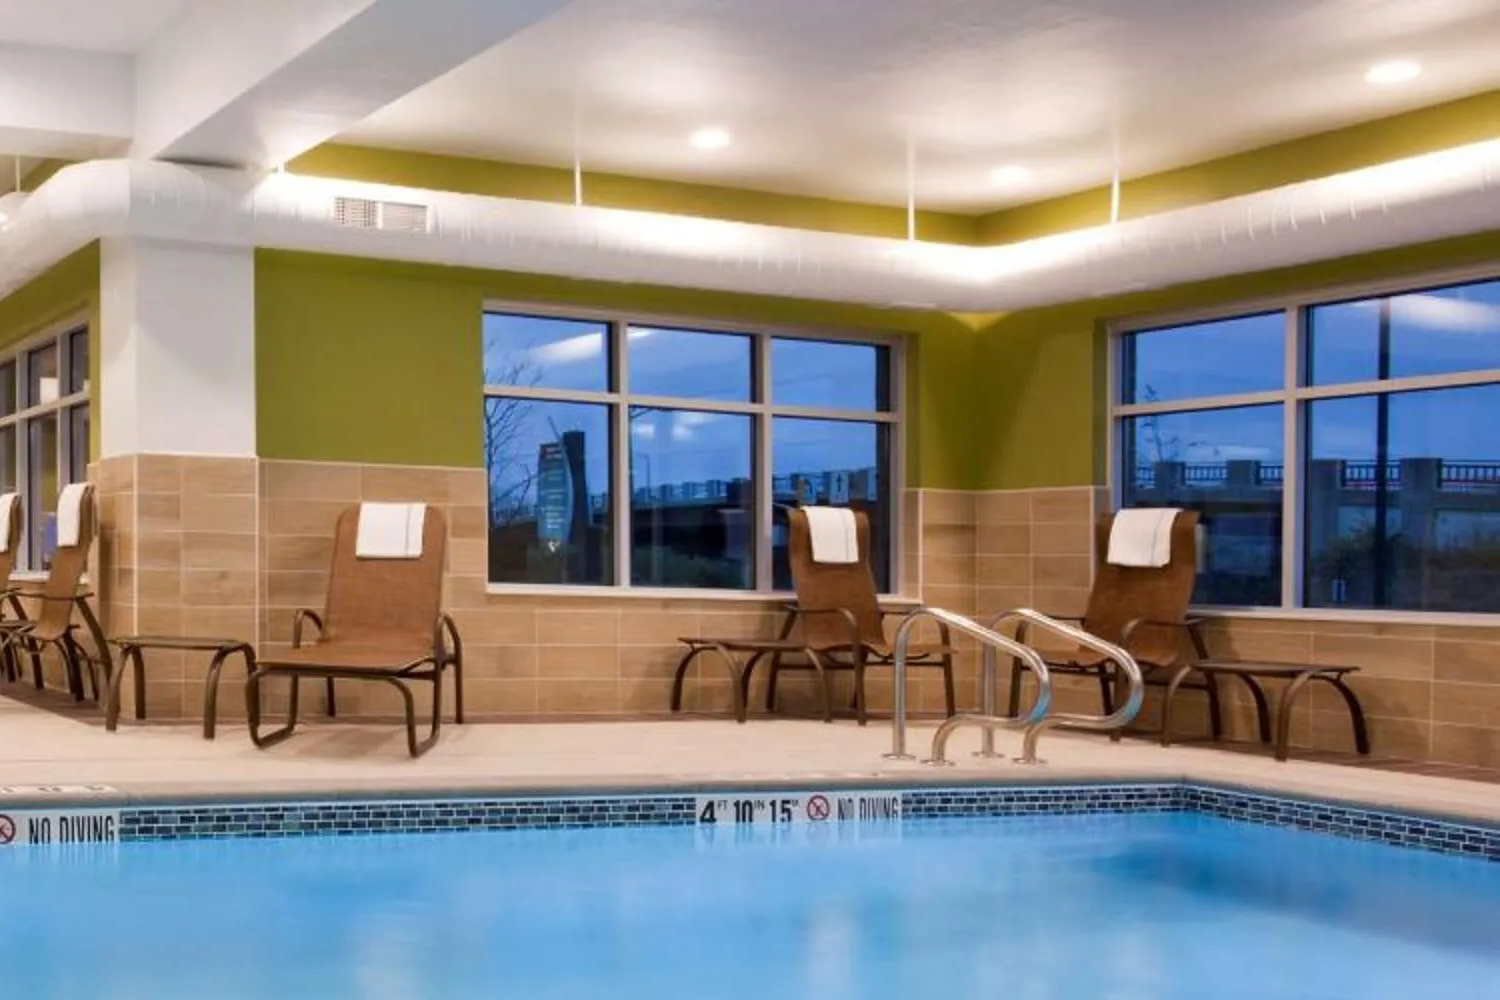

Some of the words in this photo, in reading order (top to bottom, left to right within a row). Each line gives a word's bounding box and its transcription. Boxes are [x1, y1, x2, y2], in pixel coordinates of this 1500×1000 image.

[859, 796, 899, 821] DIVING
[28, 816, 51, 844] NO
[59, 815, 115, 844] DIVING
